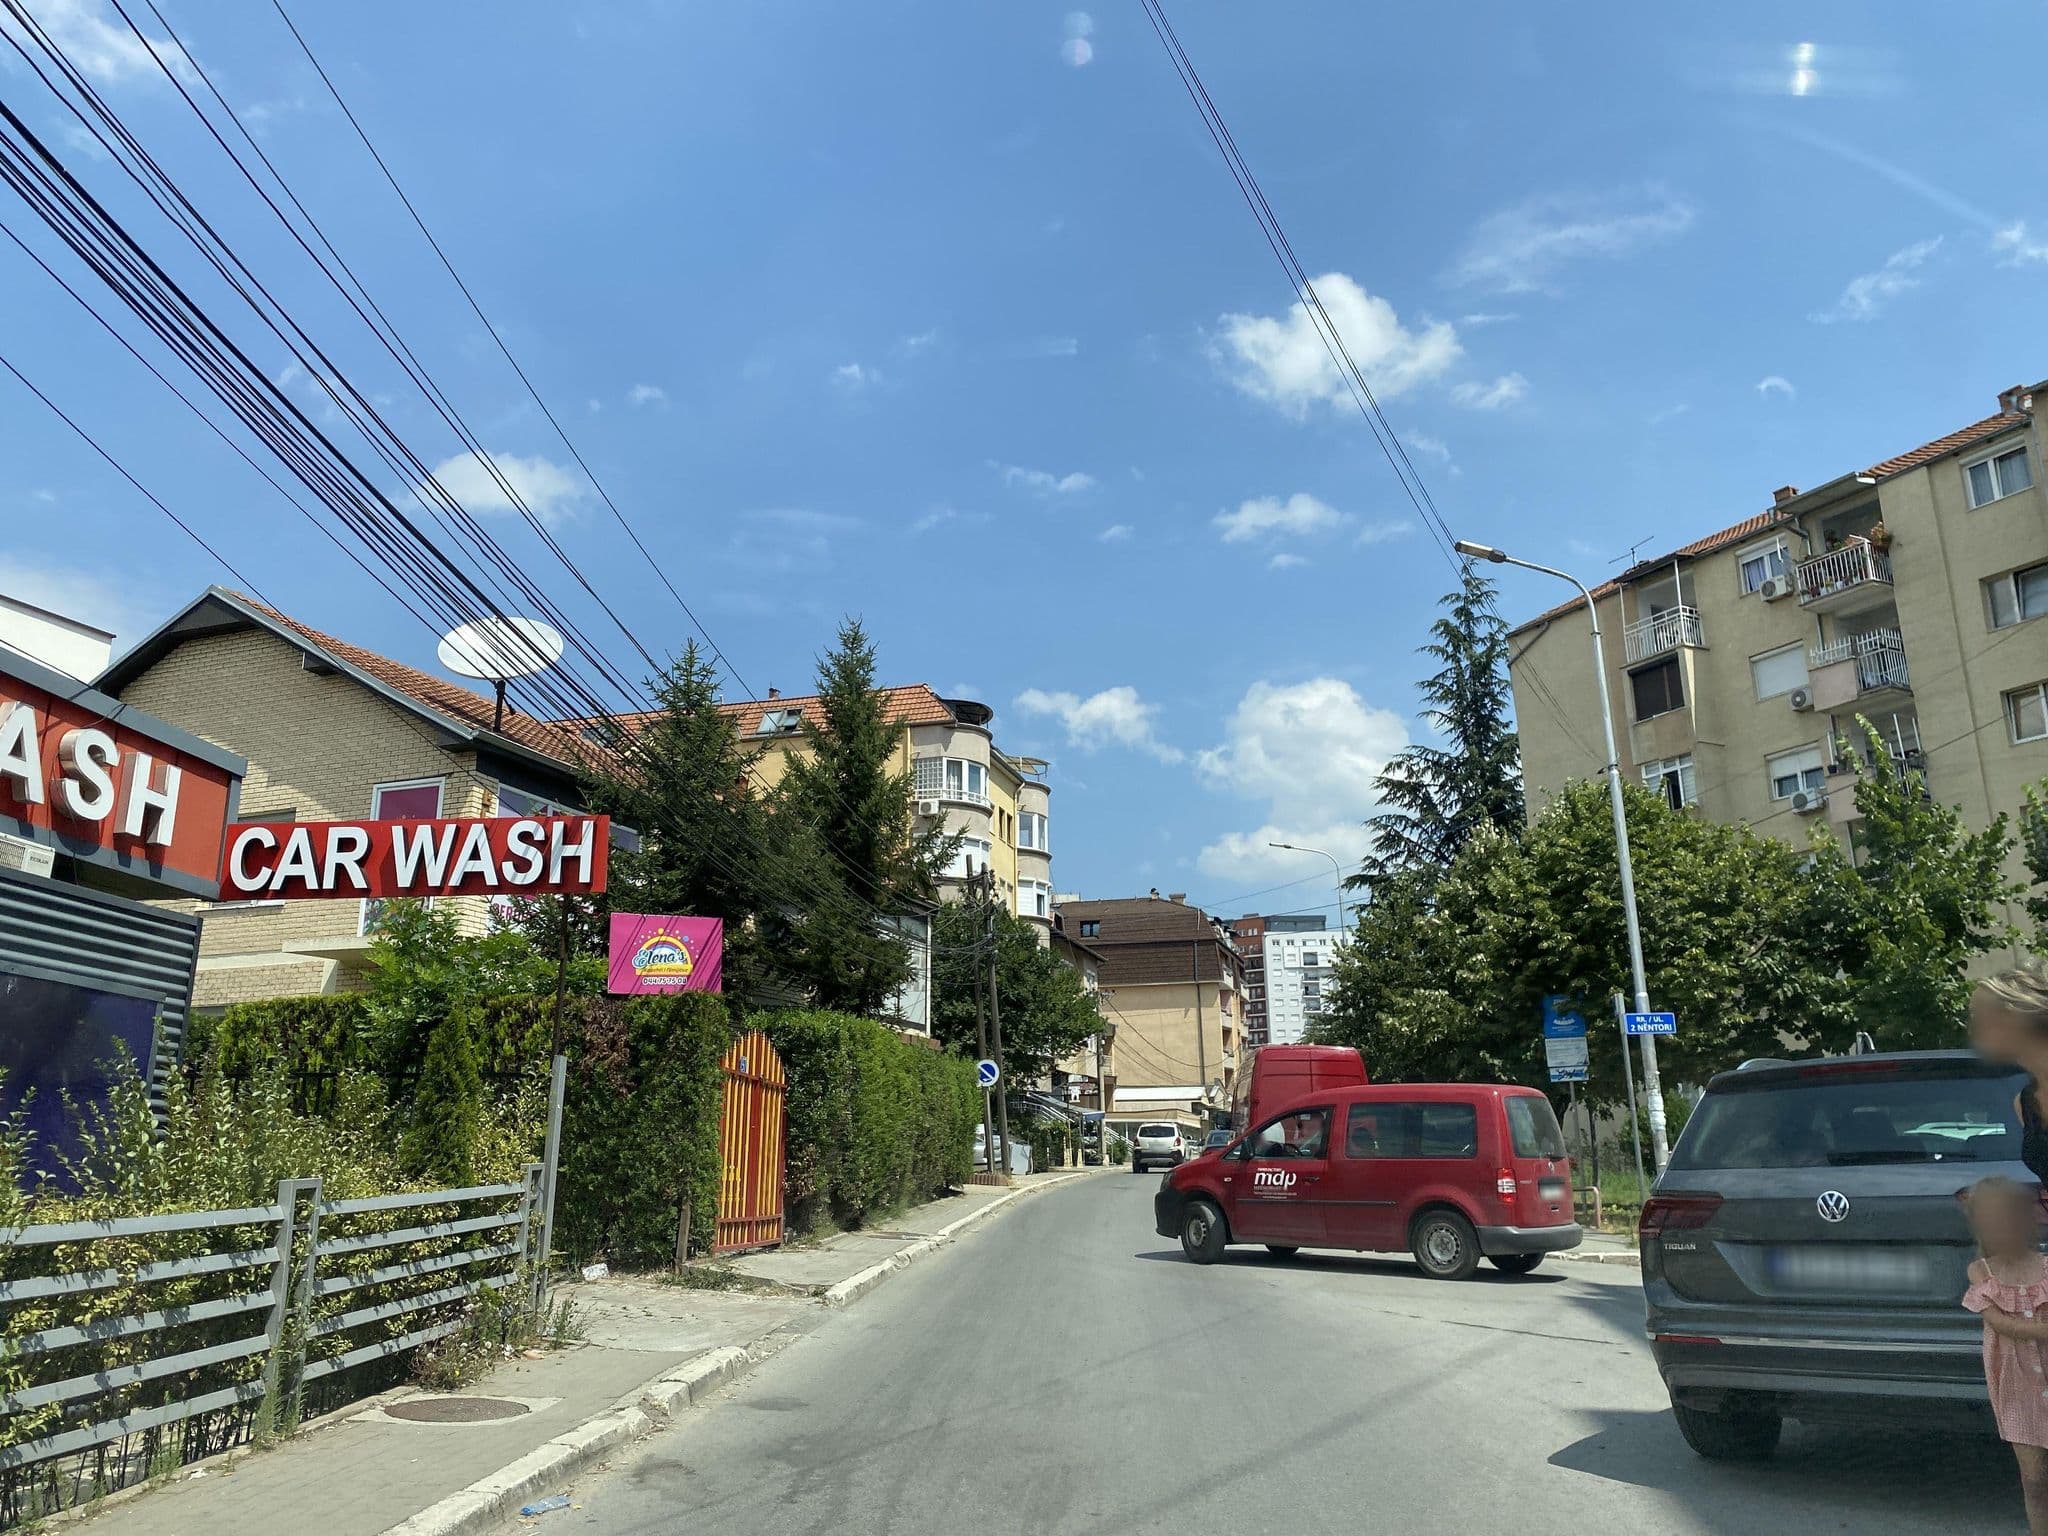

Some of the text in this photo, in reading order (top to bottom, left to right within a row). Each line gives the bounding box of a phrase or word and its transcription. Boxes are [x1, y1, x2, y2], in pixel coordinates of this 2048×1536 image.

[229, 820, 595, 892] CAR WASH
[632, 948, 686, 968] Elena's
